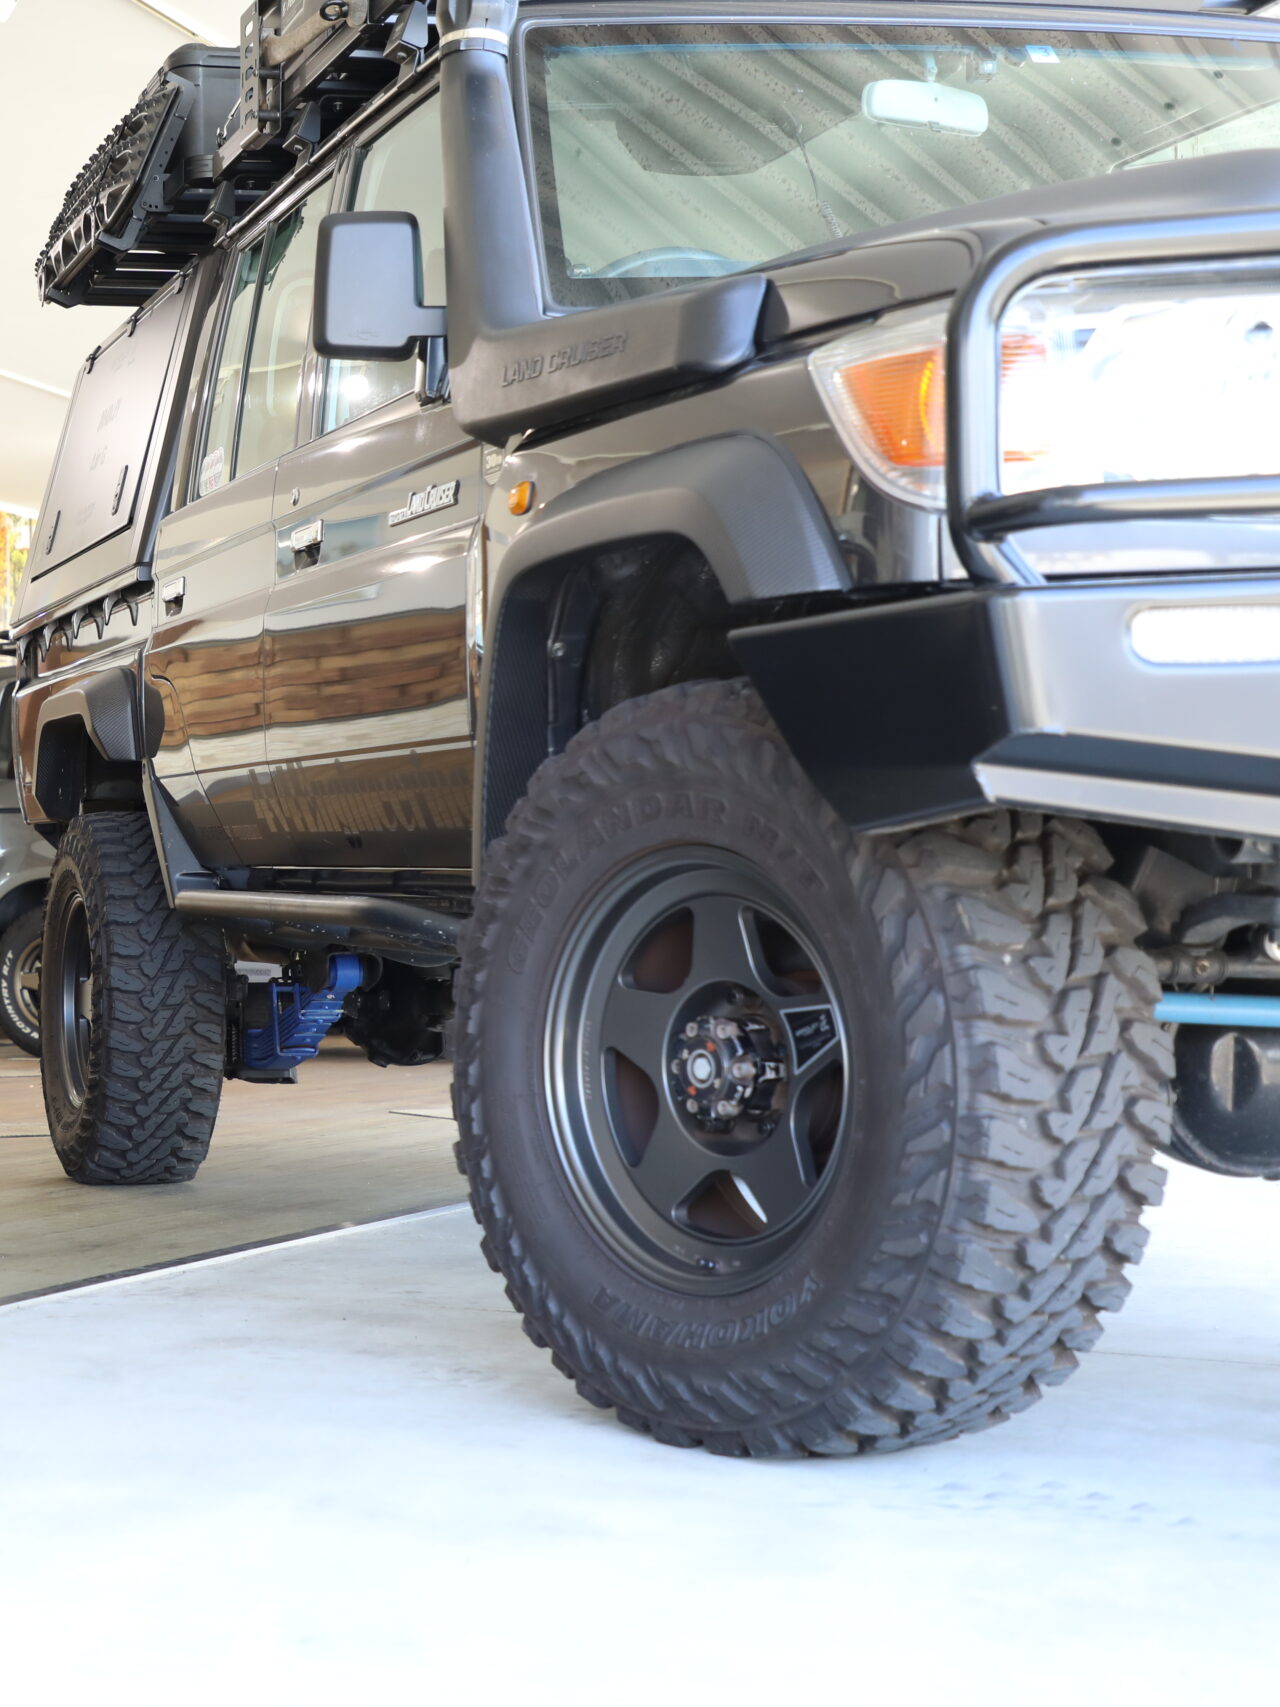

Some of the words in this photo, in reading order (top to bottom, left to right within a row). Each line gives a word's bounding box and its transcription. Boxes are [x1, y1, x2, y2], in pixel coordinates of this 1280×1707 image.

[501, 354, 545, 388] LAND
[547, 332, 629, 374] CRUISER
[2, 949, 14, 976] R/T
[1, 978, 31, 1034] COUNTRY
[591, 1270, 822, 1350] YOKOHAMA
